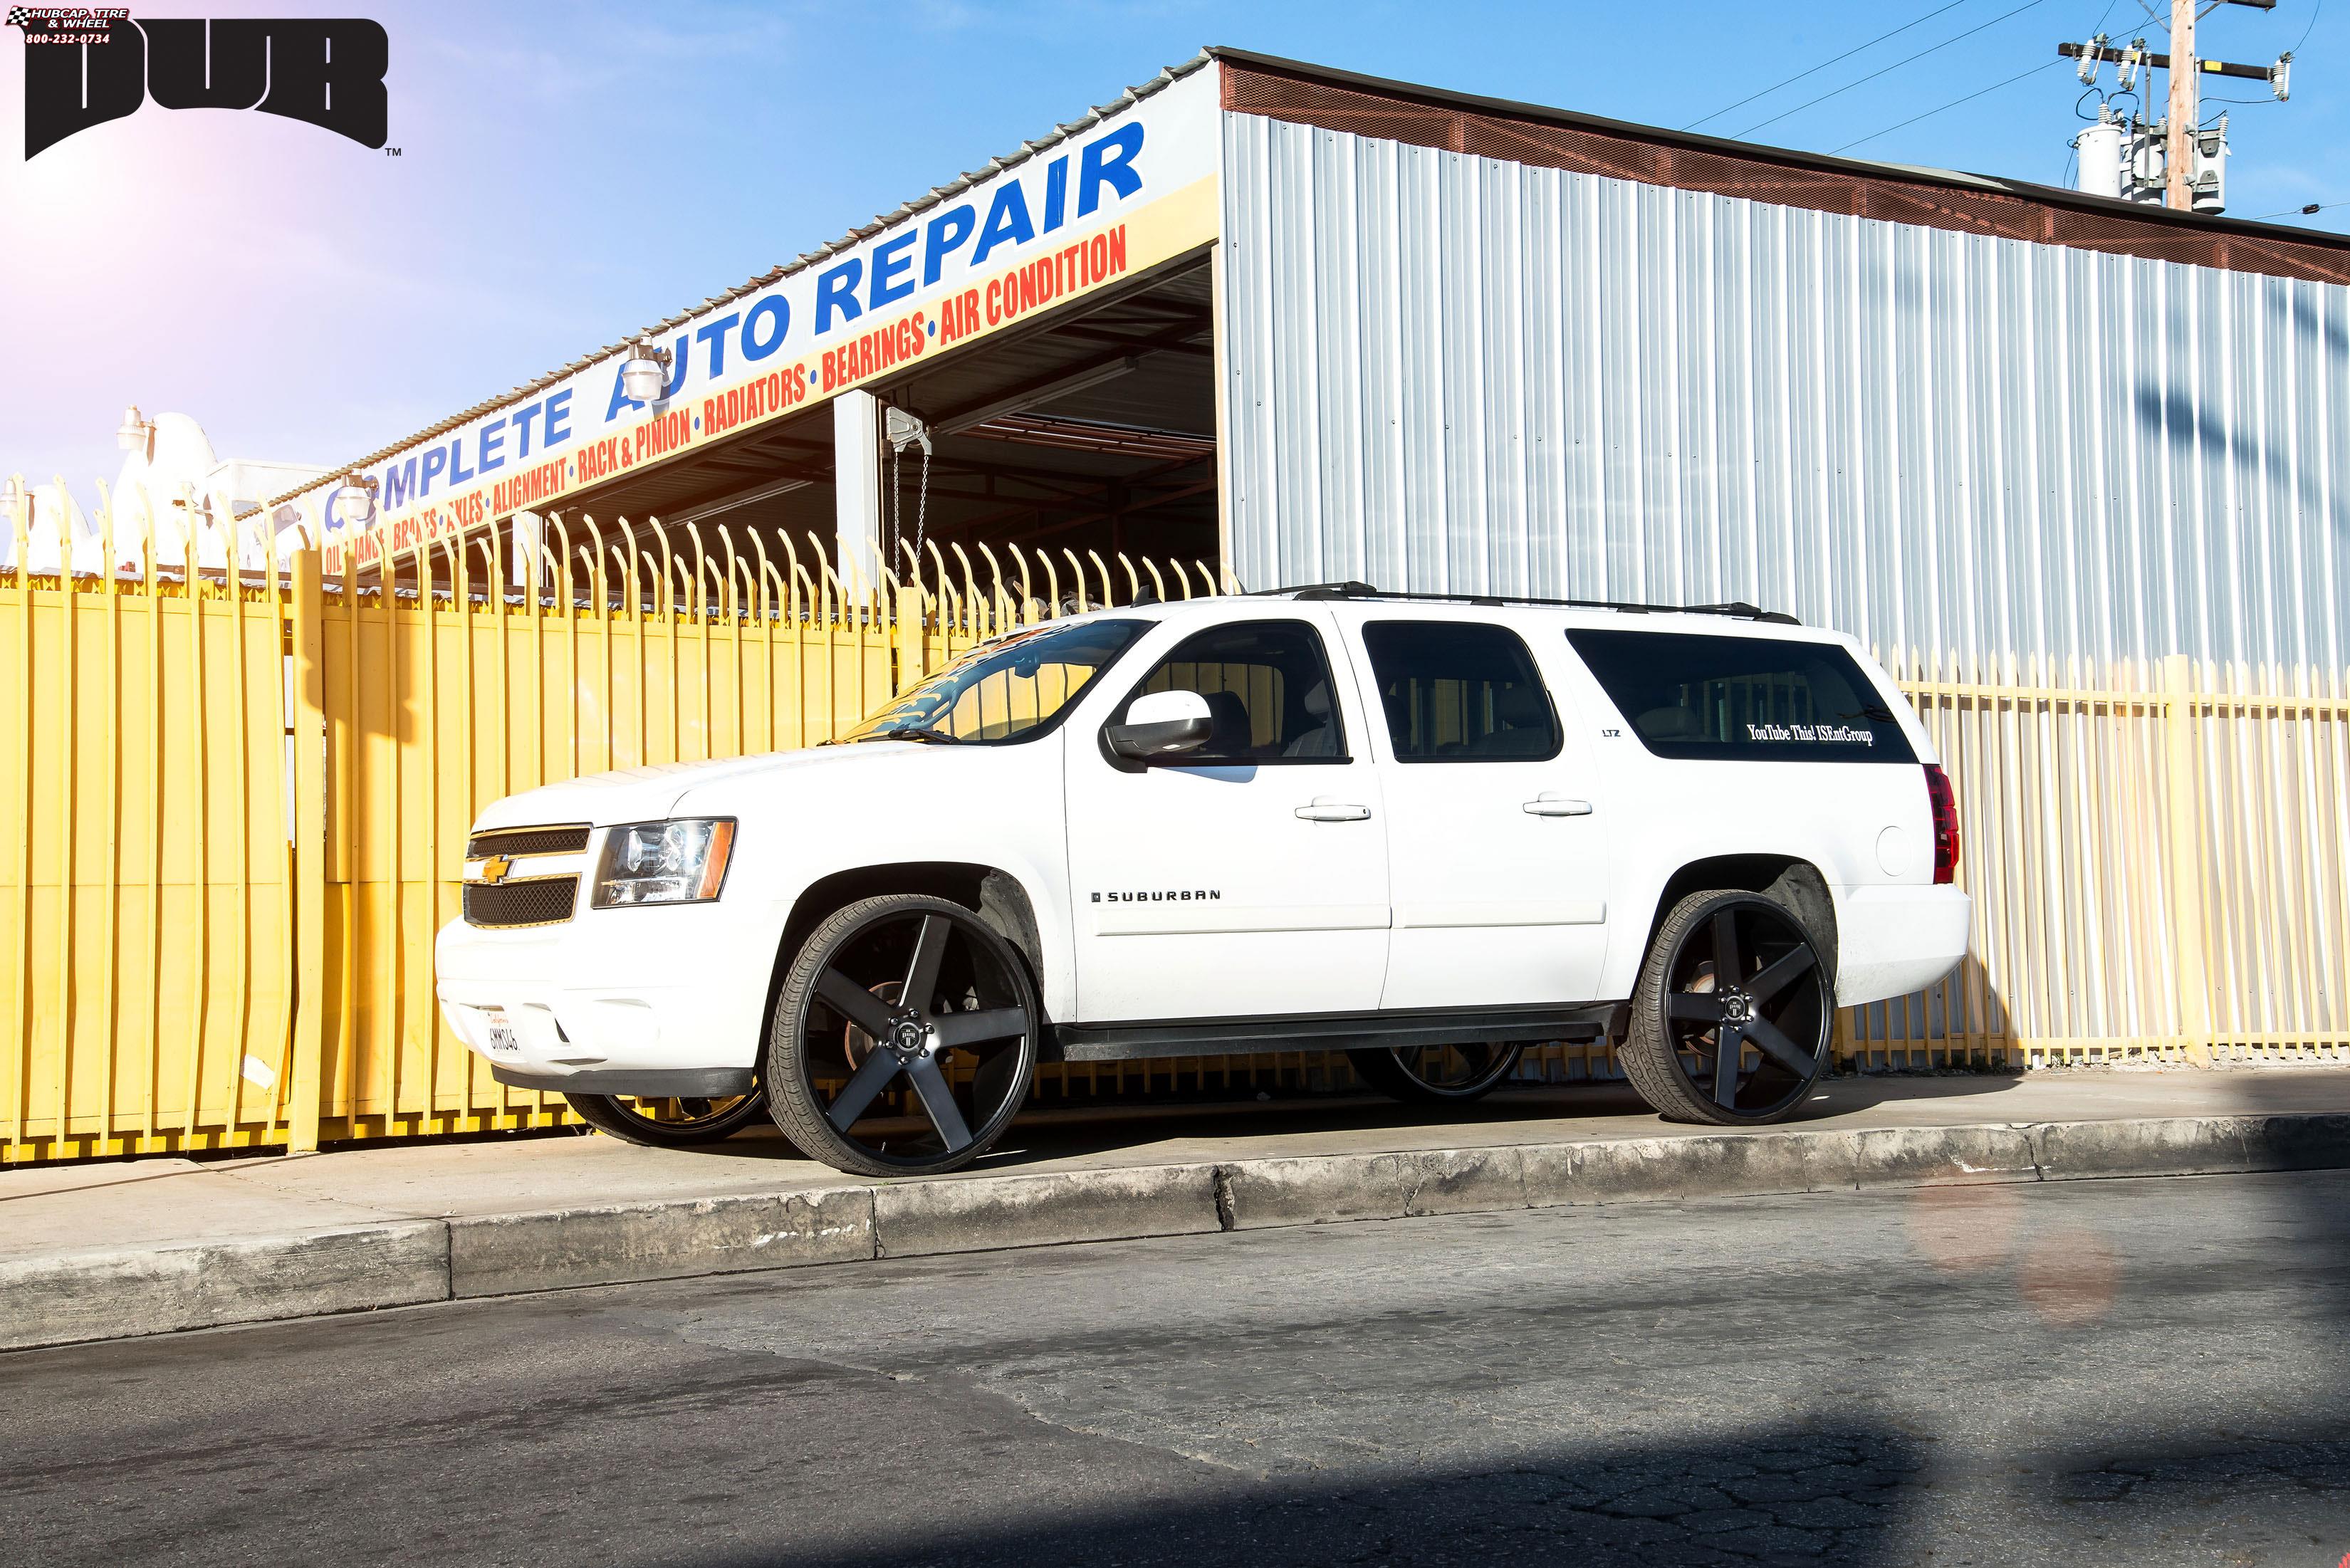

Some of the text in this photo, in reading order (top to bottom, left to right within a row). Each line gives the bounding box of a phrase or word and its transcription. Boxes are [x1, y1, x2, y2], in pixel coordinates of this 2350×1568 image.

[605, 294, 790, 423] AUTO
[815, 121, 1144, 335] REPAIR
[326, 545, 342, 575] OIL
[493, 457, 567, 516] ALIGNMENT
[578, 437, 617, 484] RACK
[622, 437, 633, 469] &
[636, 407, 691, 462] PINION
[704, 363, 805, 437] RADIATORS
[822, 311, 925, 393] BEARINGS
[940, 288, 980, 347] AIR
[986, 224, 1127, 326] CONDITION
[1747, 724, 1790, 741] YouTube
[1790, 725, 1816, 741] This!
[1107, 890, 1221, 902] SUBURBAN
